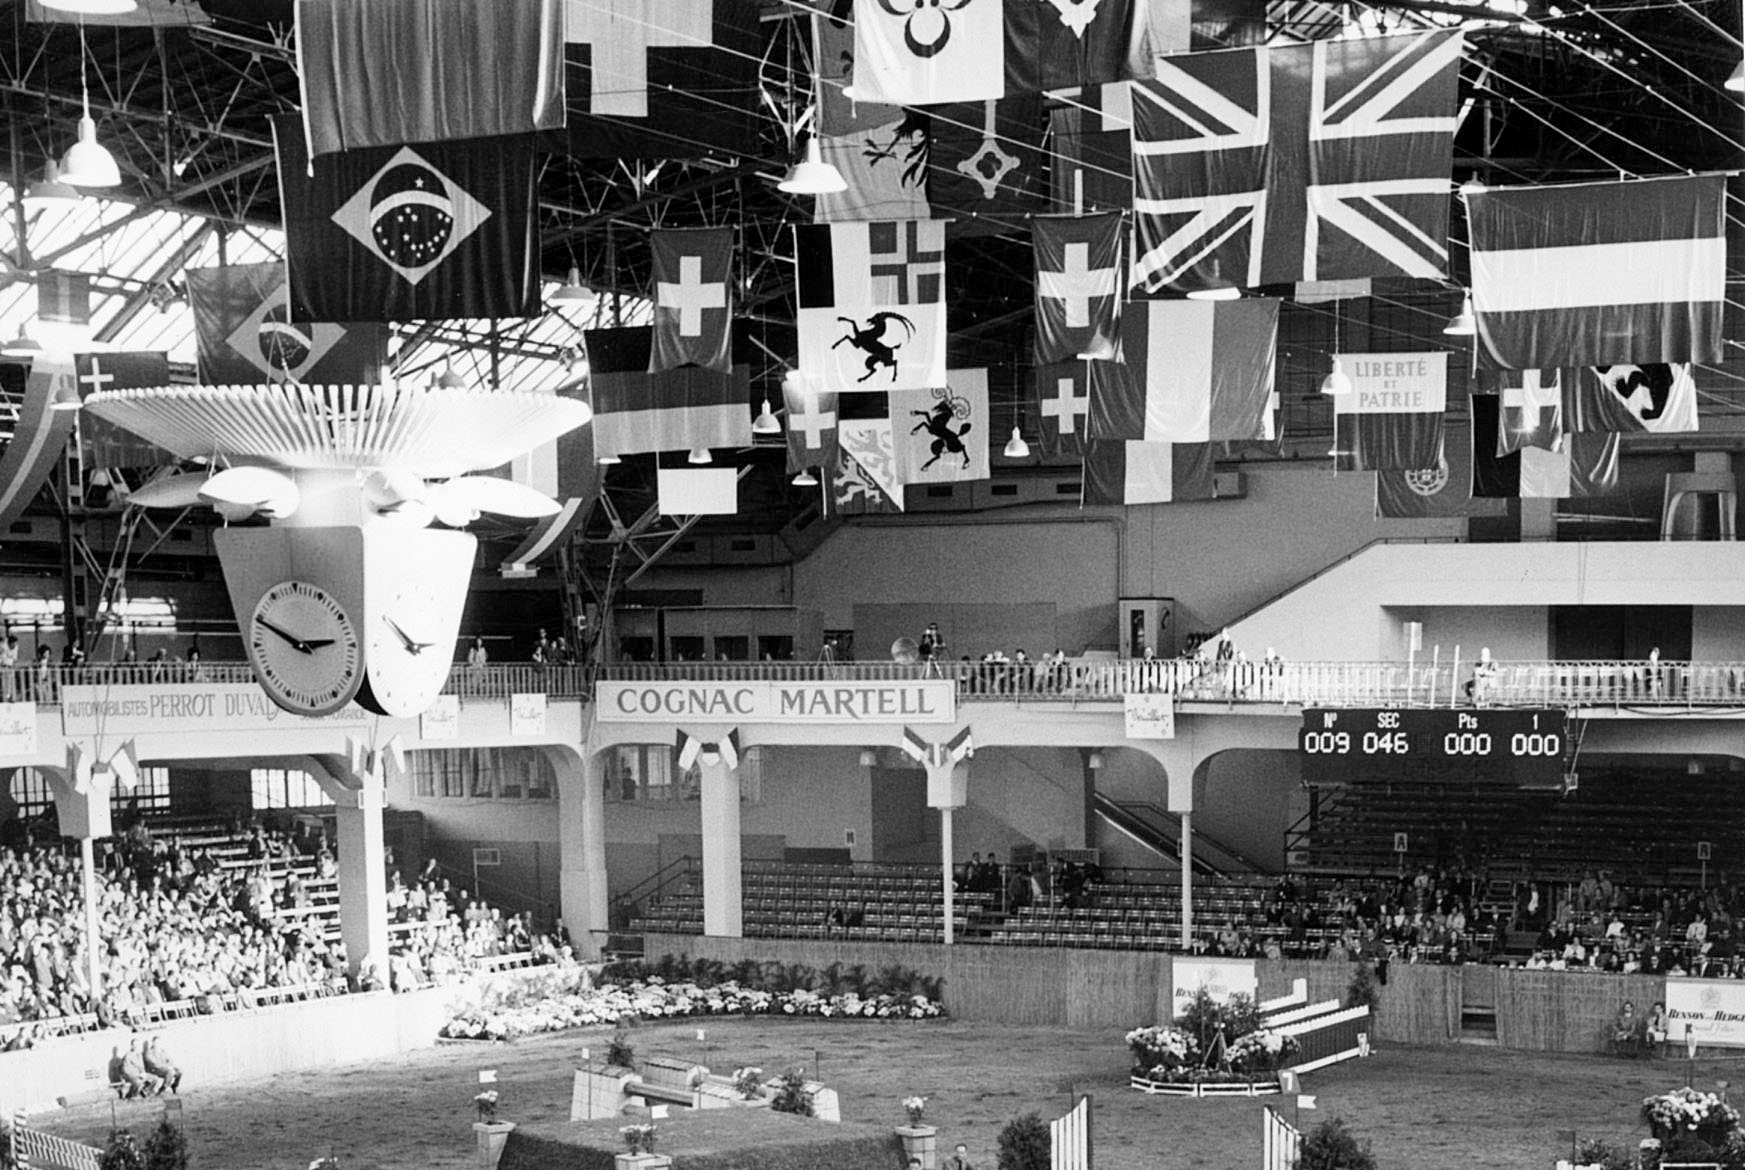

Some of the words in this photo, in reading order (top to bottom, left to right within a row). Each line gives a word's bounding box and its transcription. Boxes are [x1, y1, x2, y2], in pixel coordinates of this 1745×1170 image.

[1355, 357, 1427, 377] LIBERTÉ
[1384, 380, 1398, 389] ET
[1360, 391, 1423, 408] PATRIE
[149, 693, 215, 718] PERROT
[617, 688, 755, 714] COGNAC
[780, 688, 935, 720] MARTELL
[1377, 712, 1401, 729] SEC
[1458, 713, 1479, 730] Pts
[1532, 714, 1539, 731] 1
[1304, 731, 1351, 754] 009
[1362, 731, 1409, 754] 046
[1444, 733, 1492, 755] 000
[1511, 733, 1560, 756] 000
[1282, 1072, 1293, 1091] 7
